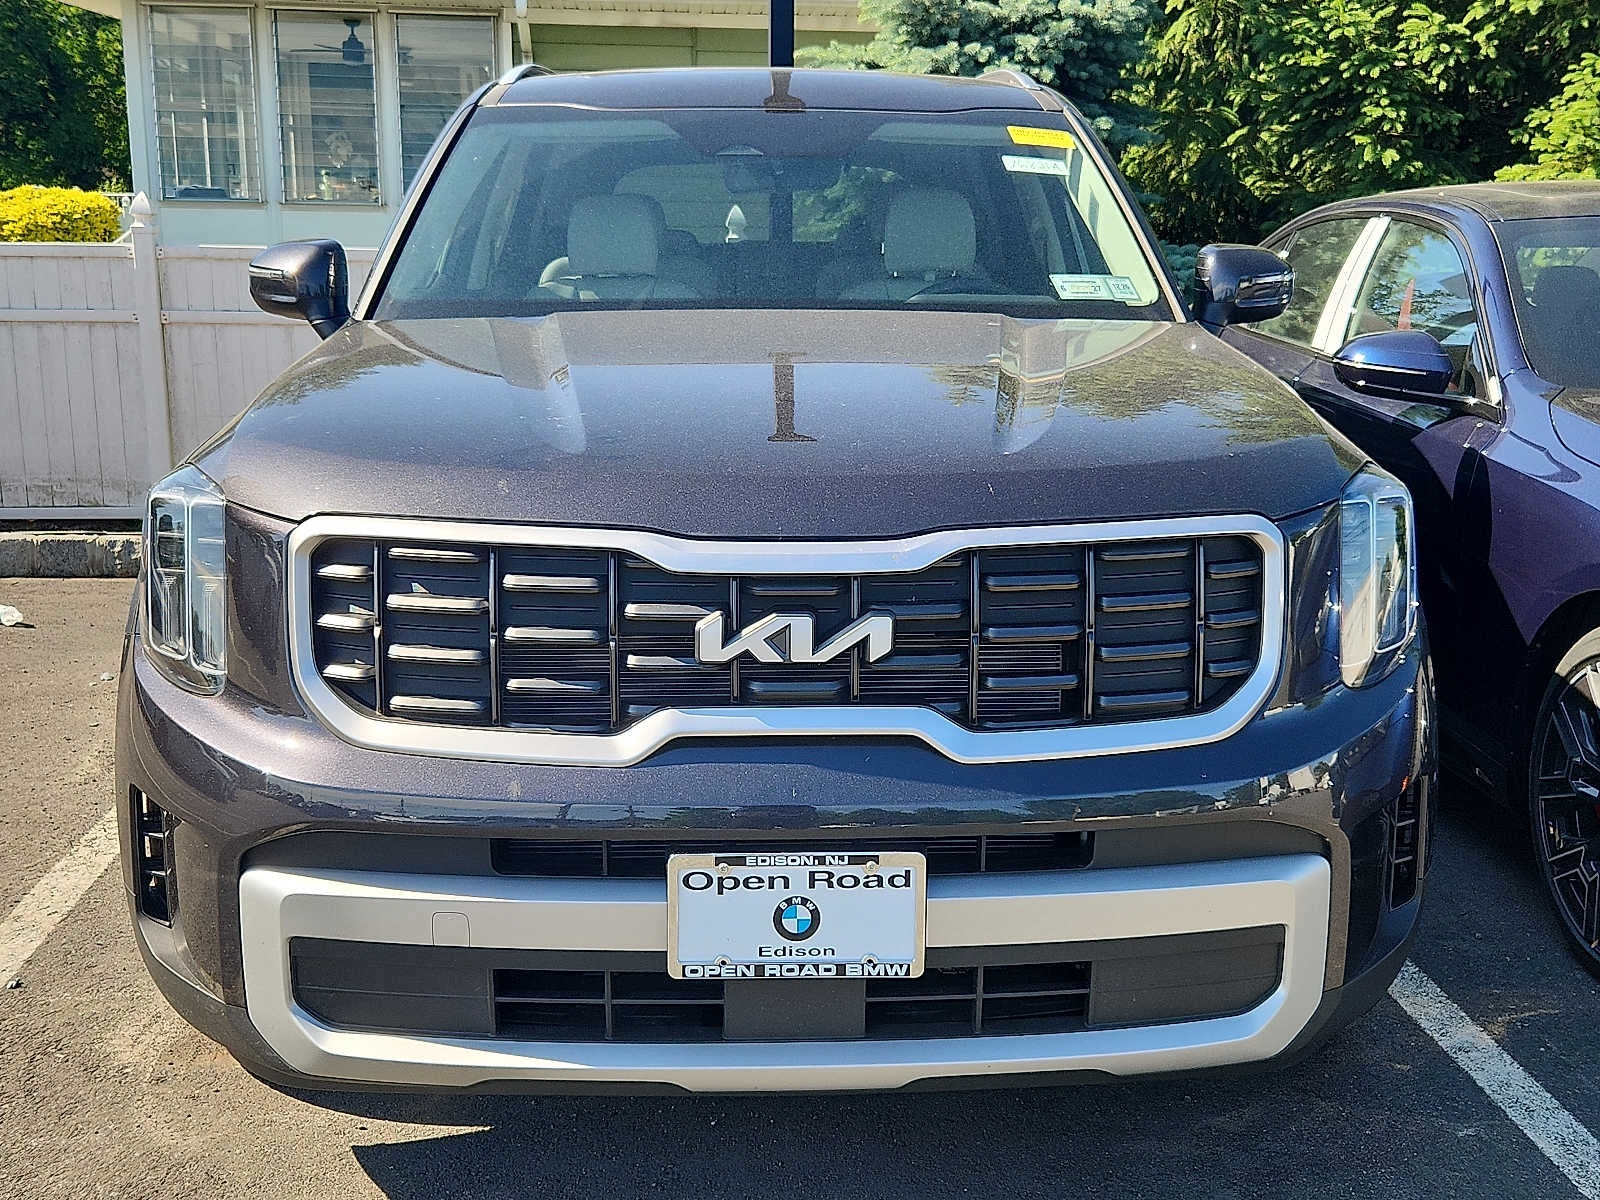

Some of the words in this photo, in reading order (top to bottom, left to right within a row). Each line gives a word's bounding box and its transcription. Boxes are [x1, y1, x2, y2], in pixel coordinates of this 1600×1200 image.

[825, 855, 849, 866] NJ
[682, 870, 790, 895] Open
[809, 869, 911, 890] Road
[779, 896, 816, 911] BMW
[758, 946, 836, 957] Edison
[684, 964, 755, 977] OPEN
[764, 964, 838, 977] ROAD
[845, 963, 909, 976] BMW
